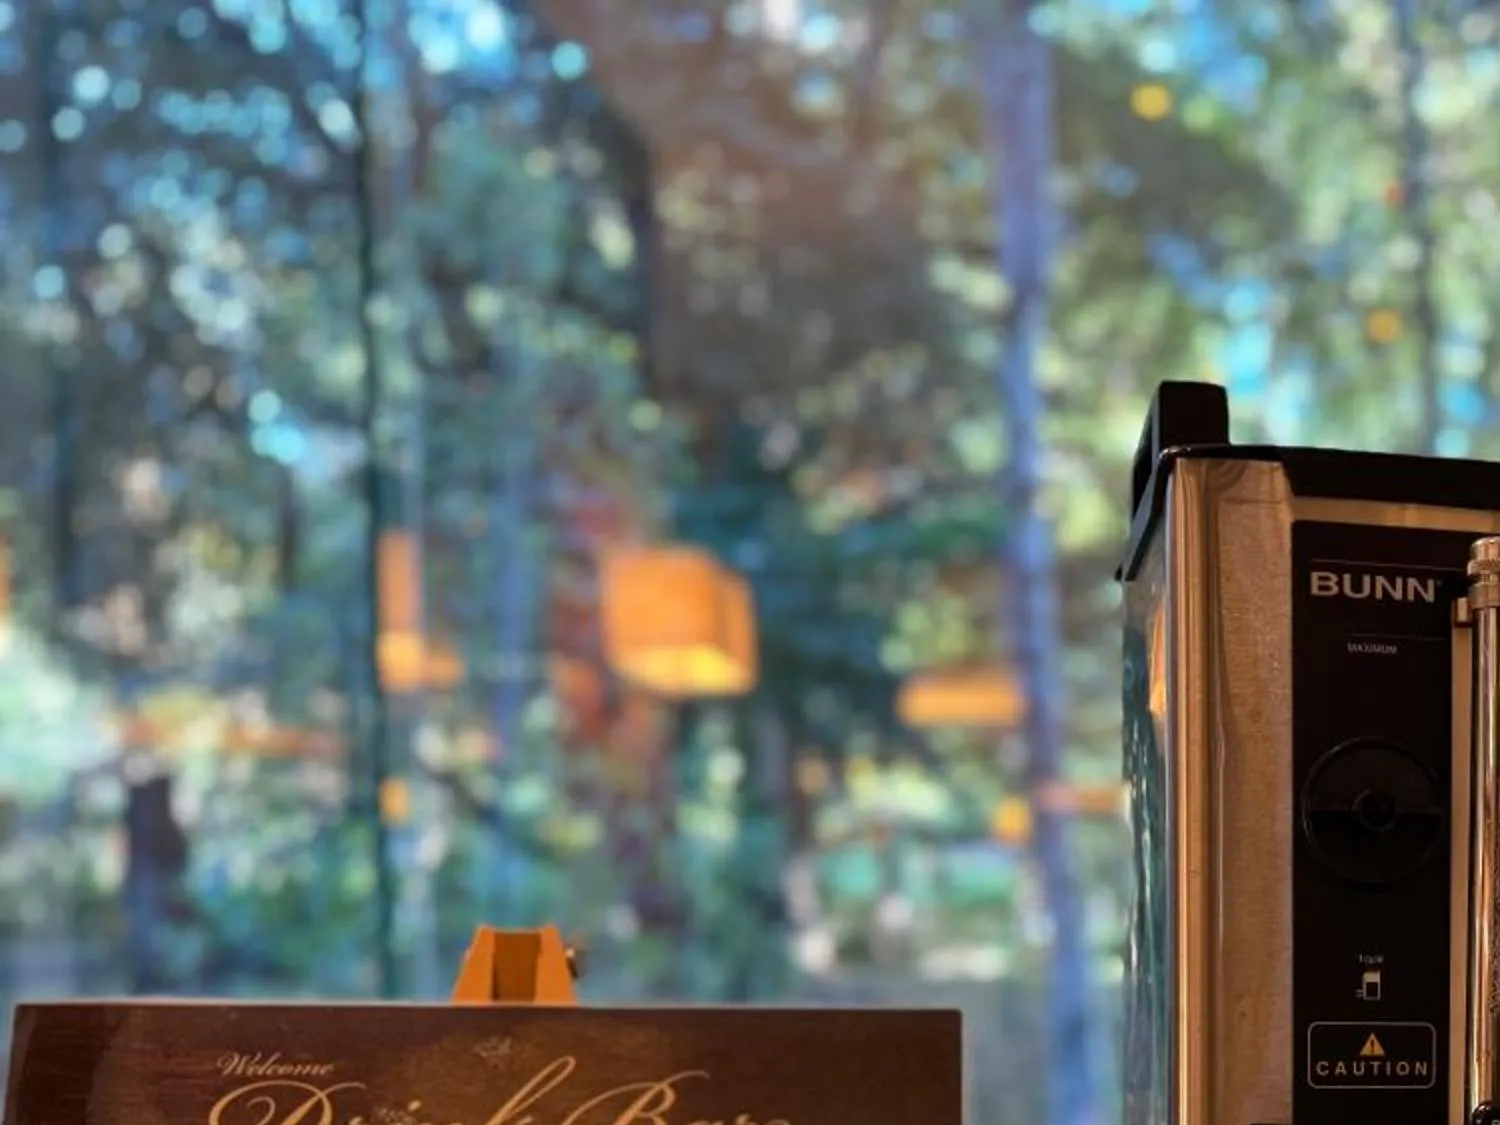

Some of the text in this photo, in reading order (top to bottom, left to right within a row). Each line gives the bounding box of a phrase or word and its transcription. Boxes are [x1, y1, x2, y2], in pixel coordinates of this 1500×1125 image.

[1310, 571, 1435, 603] BUNN
[217, 1051, 334, 1077] Welcome
[1316, 1061, 1427, 1077] CAUTION
